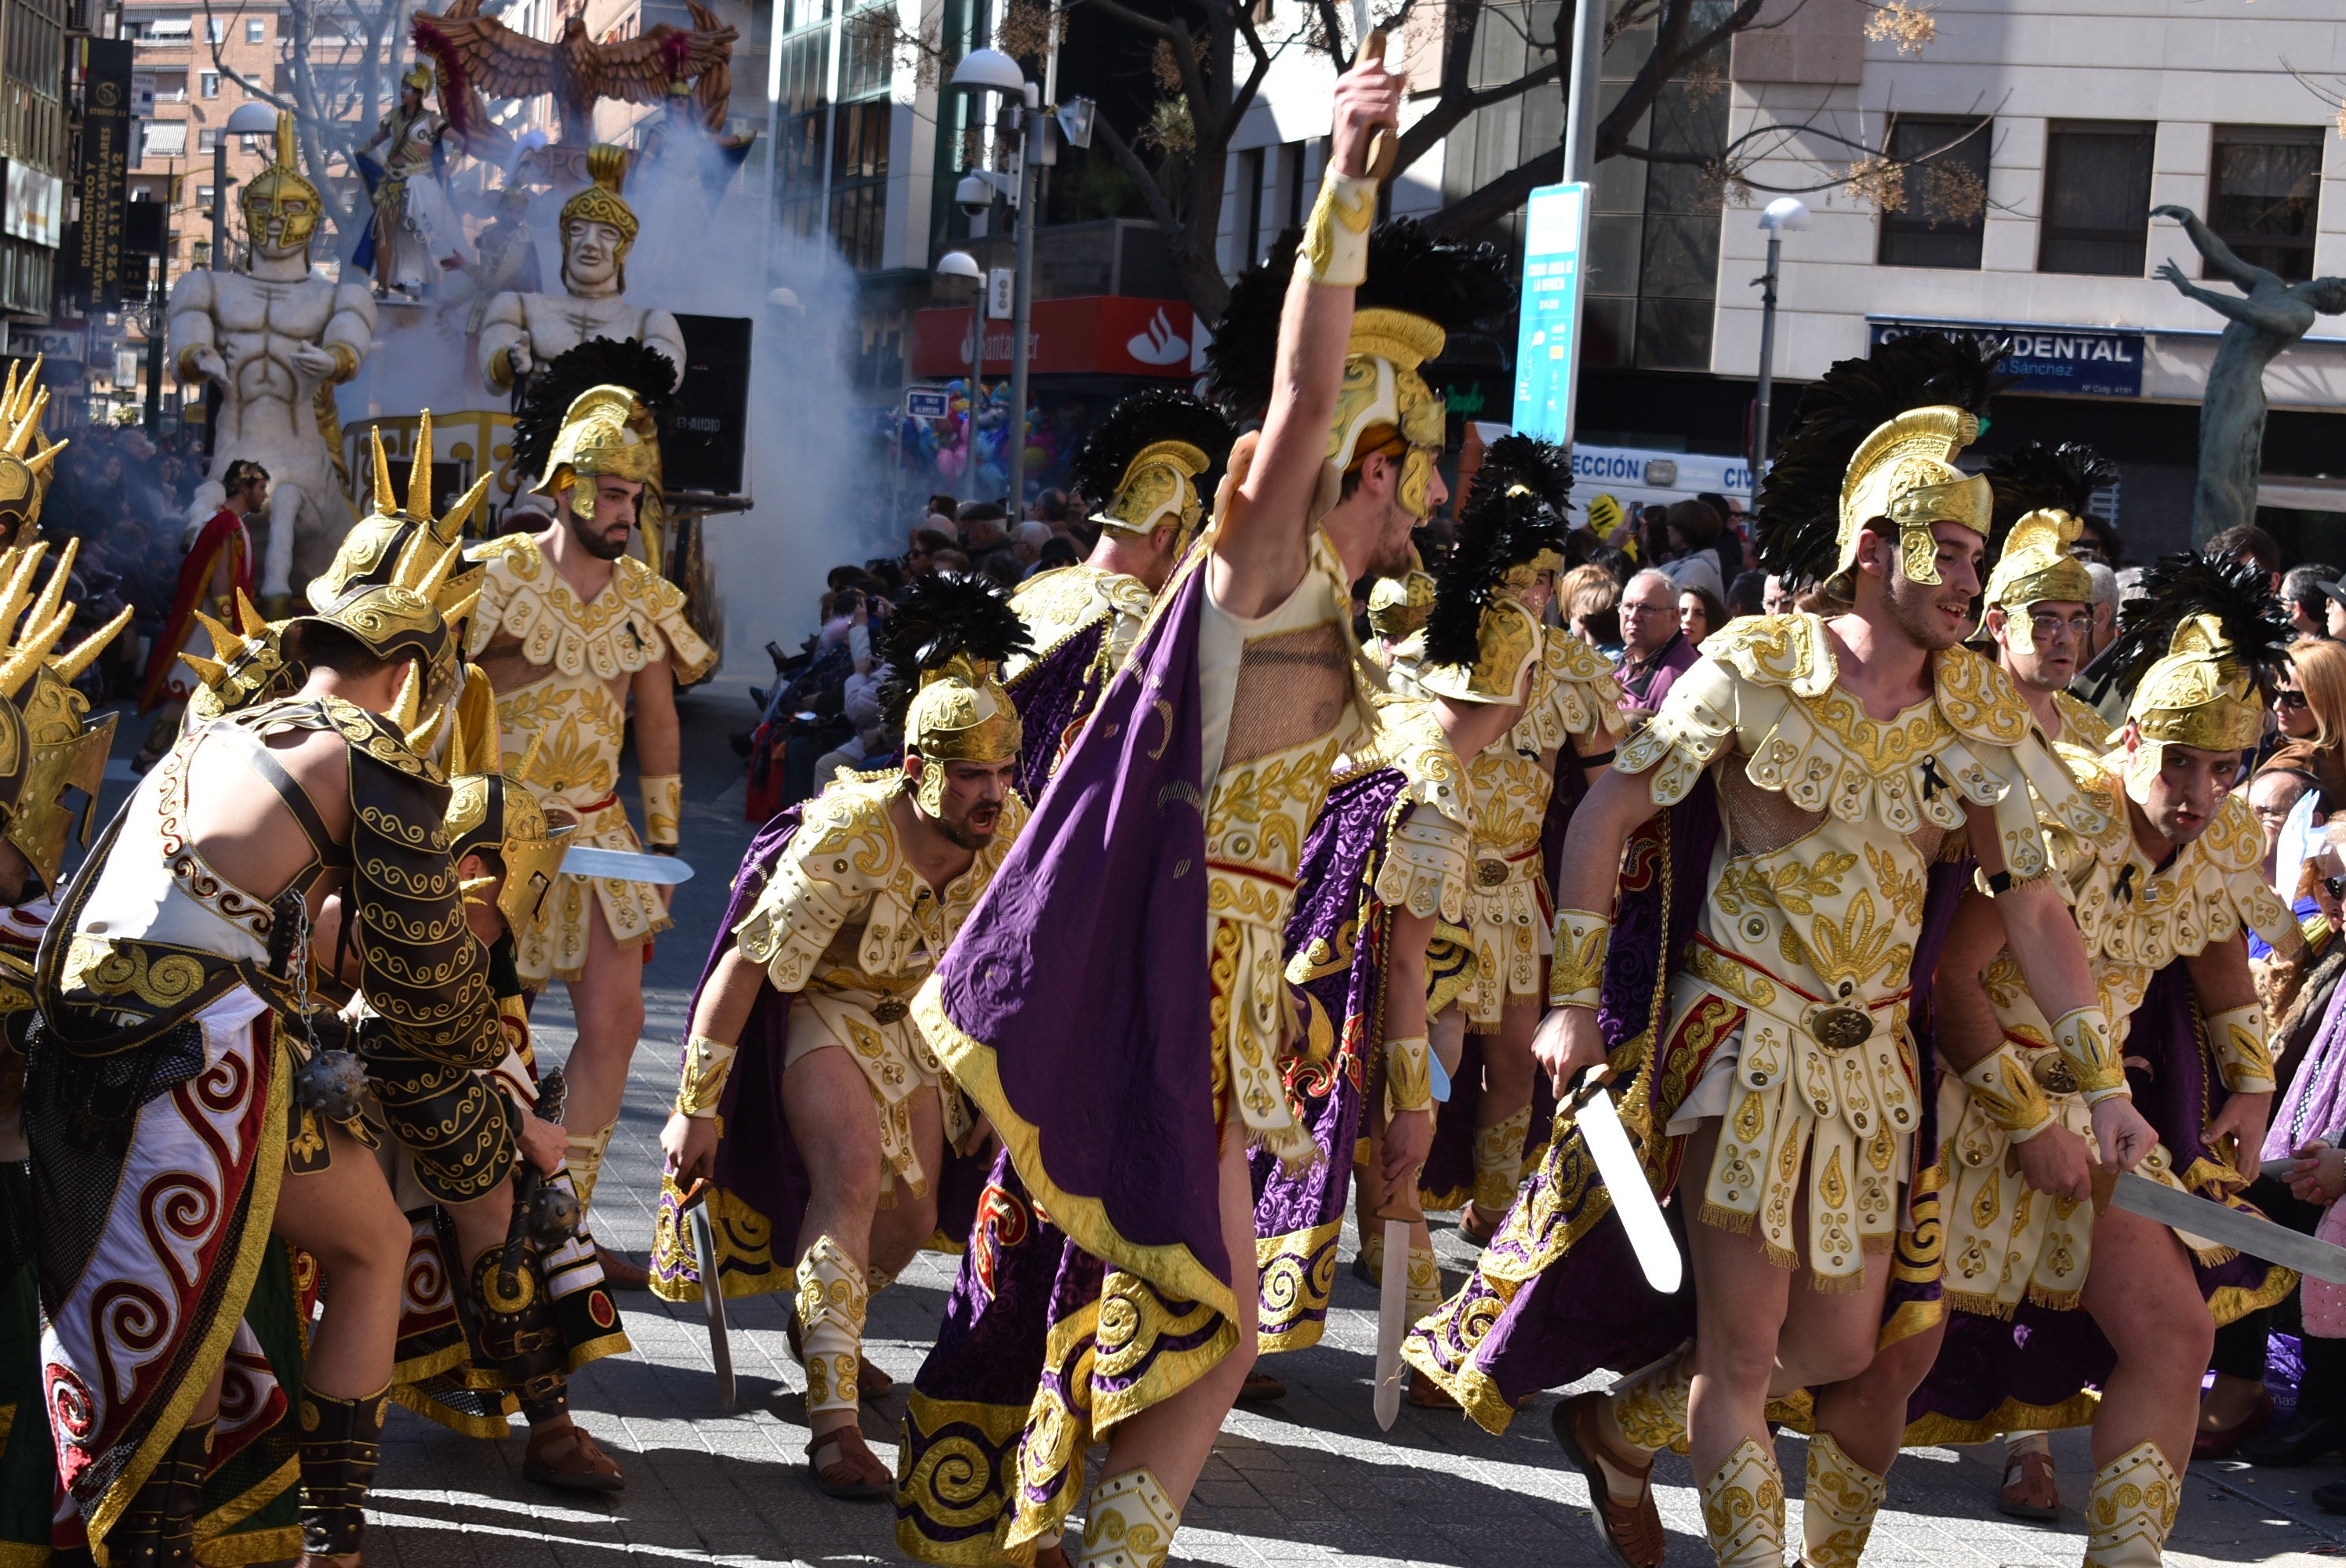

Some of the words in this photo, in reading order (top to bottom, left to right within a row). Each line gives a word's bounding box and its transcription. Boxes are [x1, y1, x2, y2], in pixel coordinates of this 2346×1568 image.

[85, 162, 96, 171] Y
[97, 126, 111, 200] CAPILARES
[111, 152, 124, 189] 142
[108, 200, 122, 236] 211
[92, 203, 107, 304] TRATAMIENTOS
[106, 243, 119, 281] 926
[7, 332, 73, 356] PTICA
[2012, 335, 2132, 363] DENTAL
[2009, 360, 2074, 377] Sánchez
[1572, 455, 1639, 480] ECCIÓN
[1724, 468, 1754, 488] CIV
